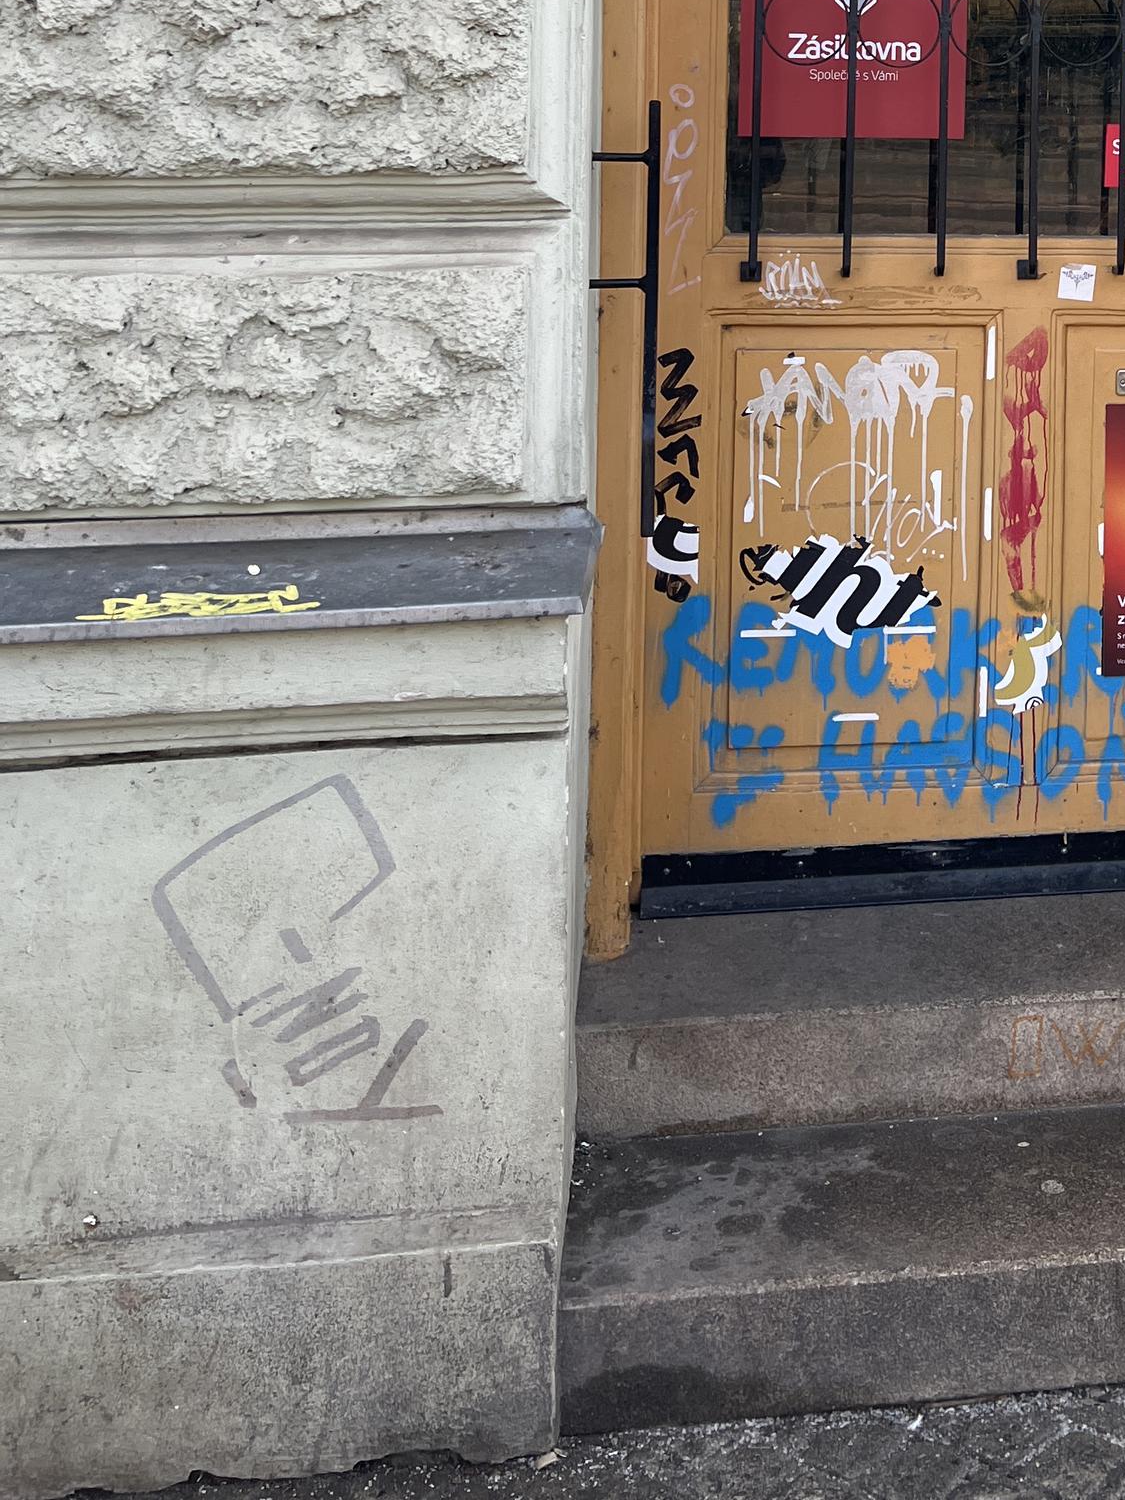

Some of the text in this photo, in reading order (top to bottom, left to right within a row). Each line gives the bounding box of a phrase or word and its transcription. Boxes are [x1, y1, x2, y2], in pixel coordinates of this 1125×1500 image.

[863, 72, 869, 80] s
[871, 70, 899, 82] Vámi
[1117, 632, 1122, 640] S
